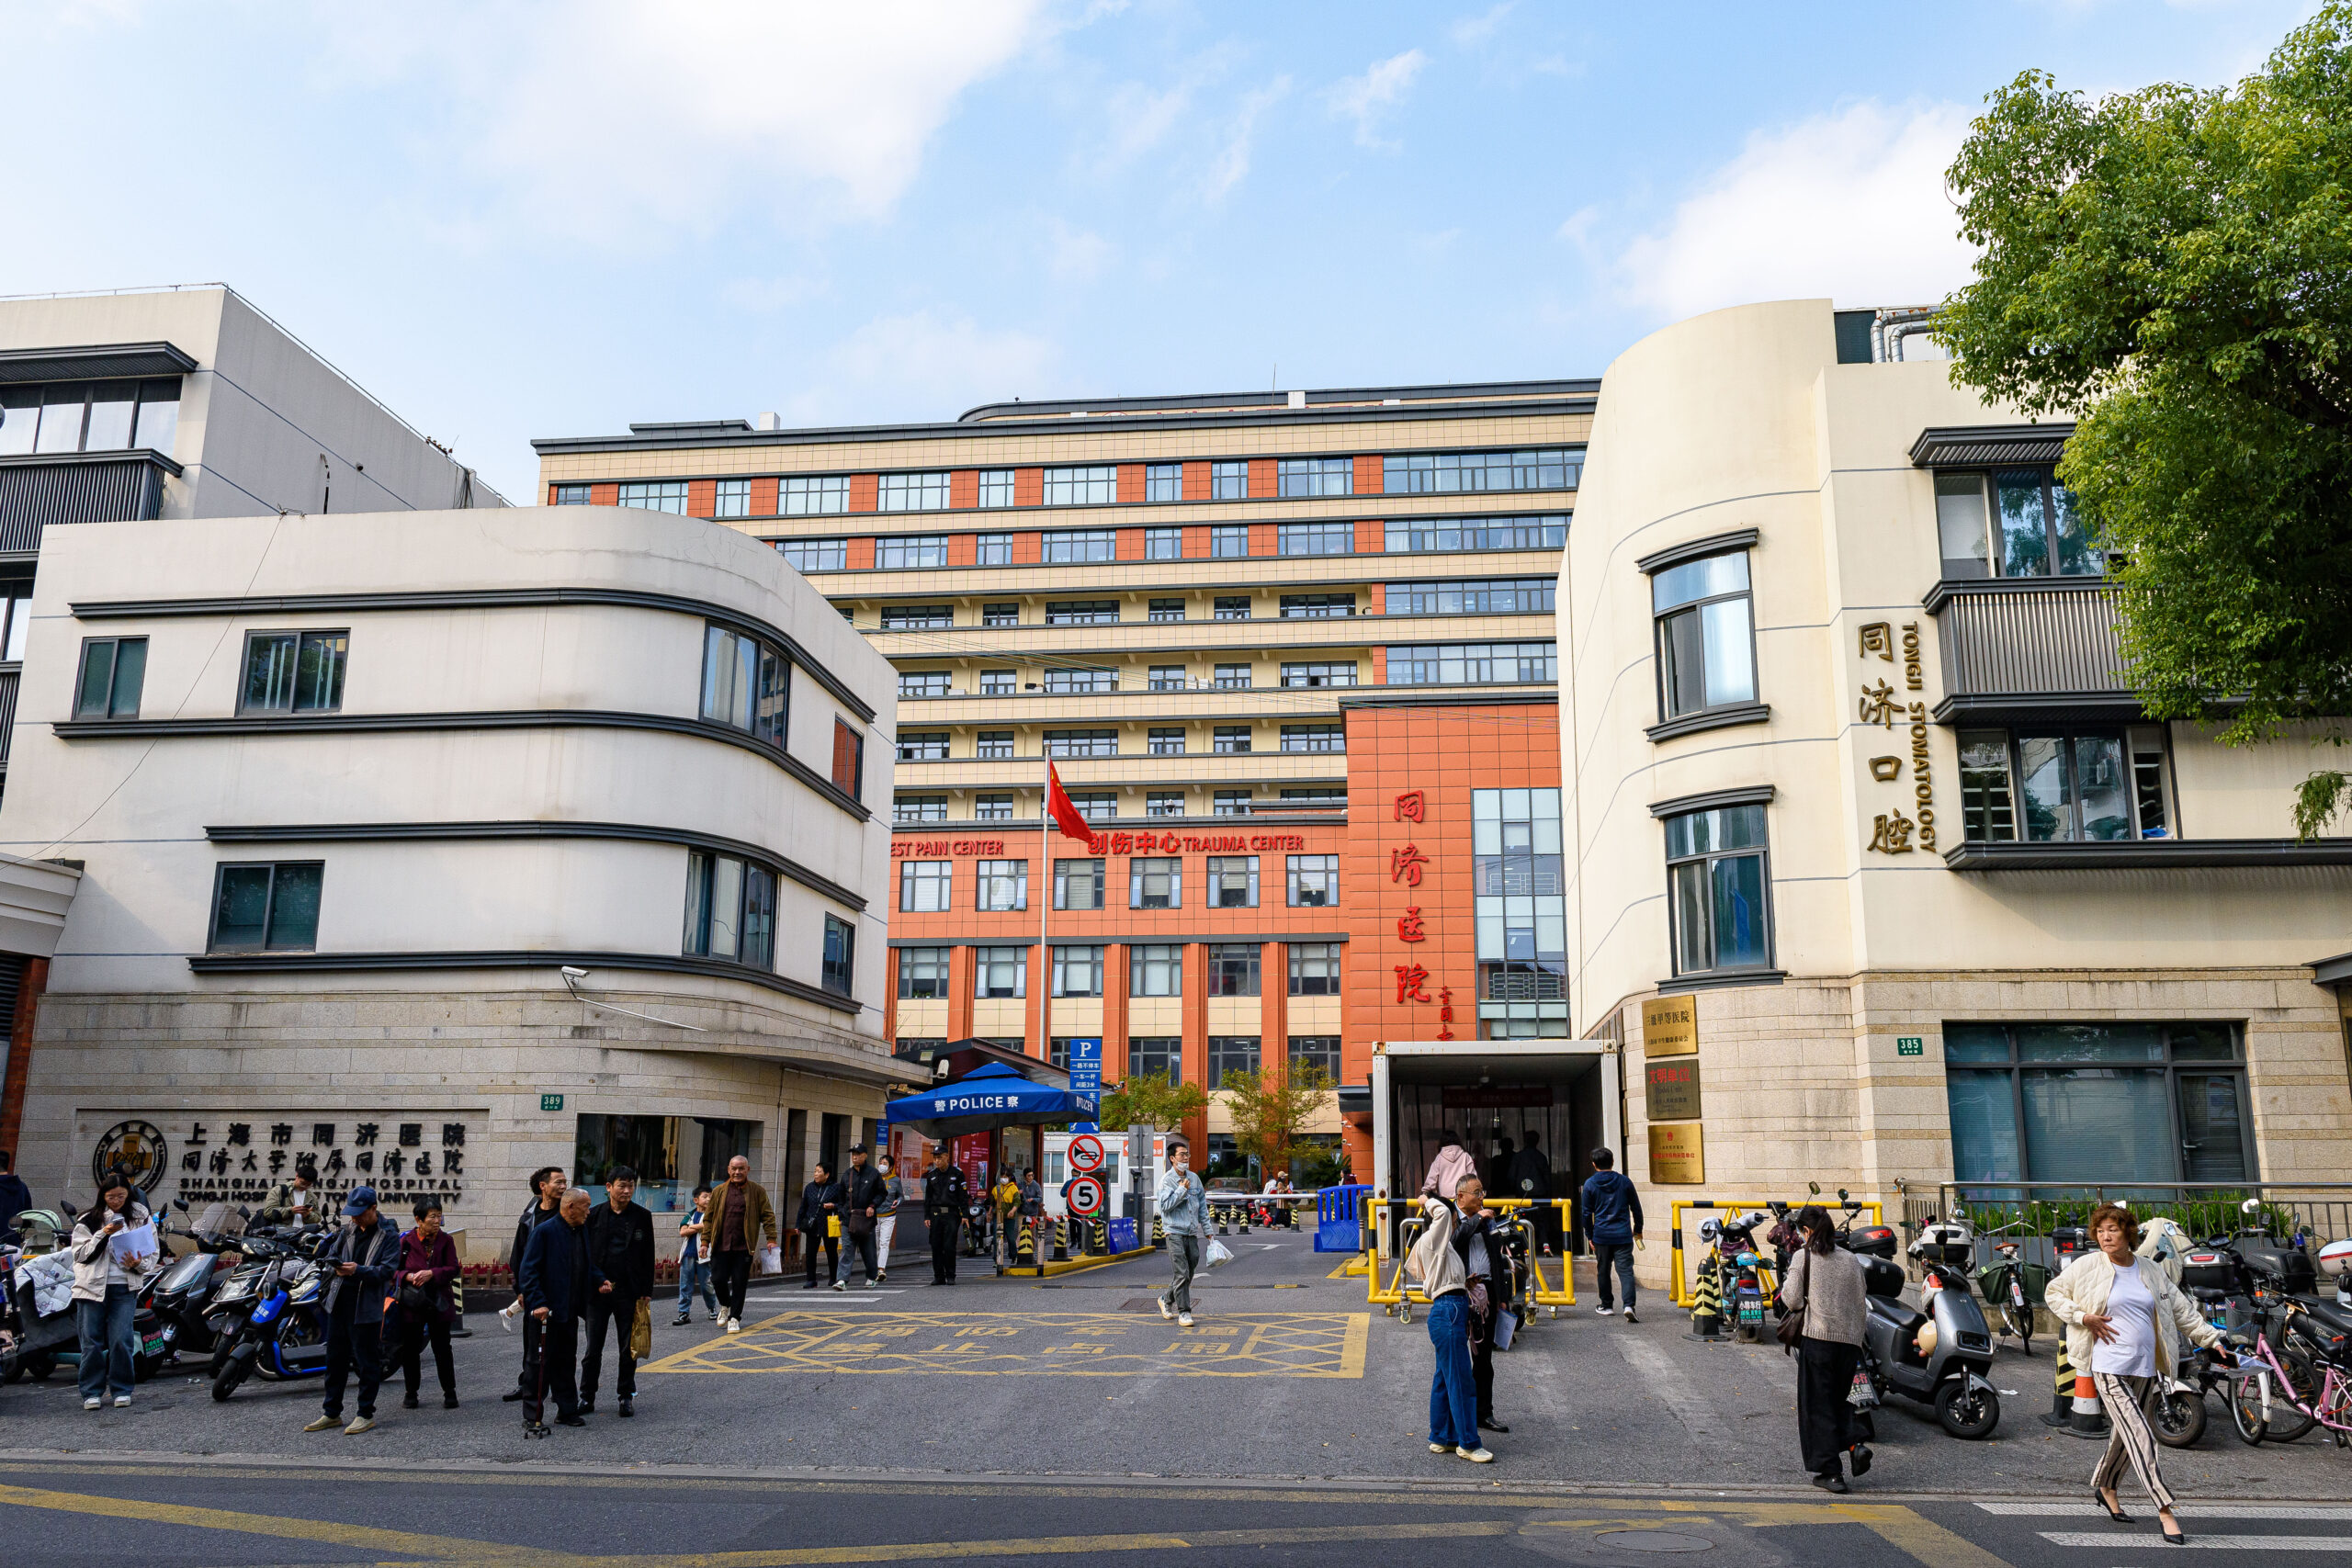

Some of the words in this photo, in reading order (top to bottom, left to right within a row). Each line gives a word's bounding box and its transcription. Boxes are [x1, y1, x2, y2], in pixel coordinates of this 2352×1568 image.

[1902, 620, 1924, 691] TONGJI
[1859, 621, 1915, 854] 同济口腔
[1908, 701, 1936, 853] STOMATOLOGY
[915, 840, 949, 856] PAIN
[952, 839, 1004, 855] CENTER
[1088, 831, 1182, 855] 创伤中心
[1182, 835, 1247, 852] TRAUMA
[1250, 834, 1304, 852] CENTER
[1080, 1042, 1091, 1057] P
[1900, 1039, 1919, 1049] 385
[1648, 1066, 1691, 1085] 文明单位
[544, 1096, 560, 1105] 389
[934, 1100, 946, 1112] 警
[949, 1096, 1003, 1111] POLICE
[1007, 1096, 1019, 1108] 察
[185, 1122, 466, 1146] 上海市同济医院
[180, 1178, 277, 1190] SHANGHAI
[366, 1178, 462, 1190] HOSPITAL
[179, 1190, 230, 1203] TONGJI
[1078, 1185, 1094, 1208] 5
